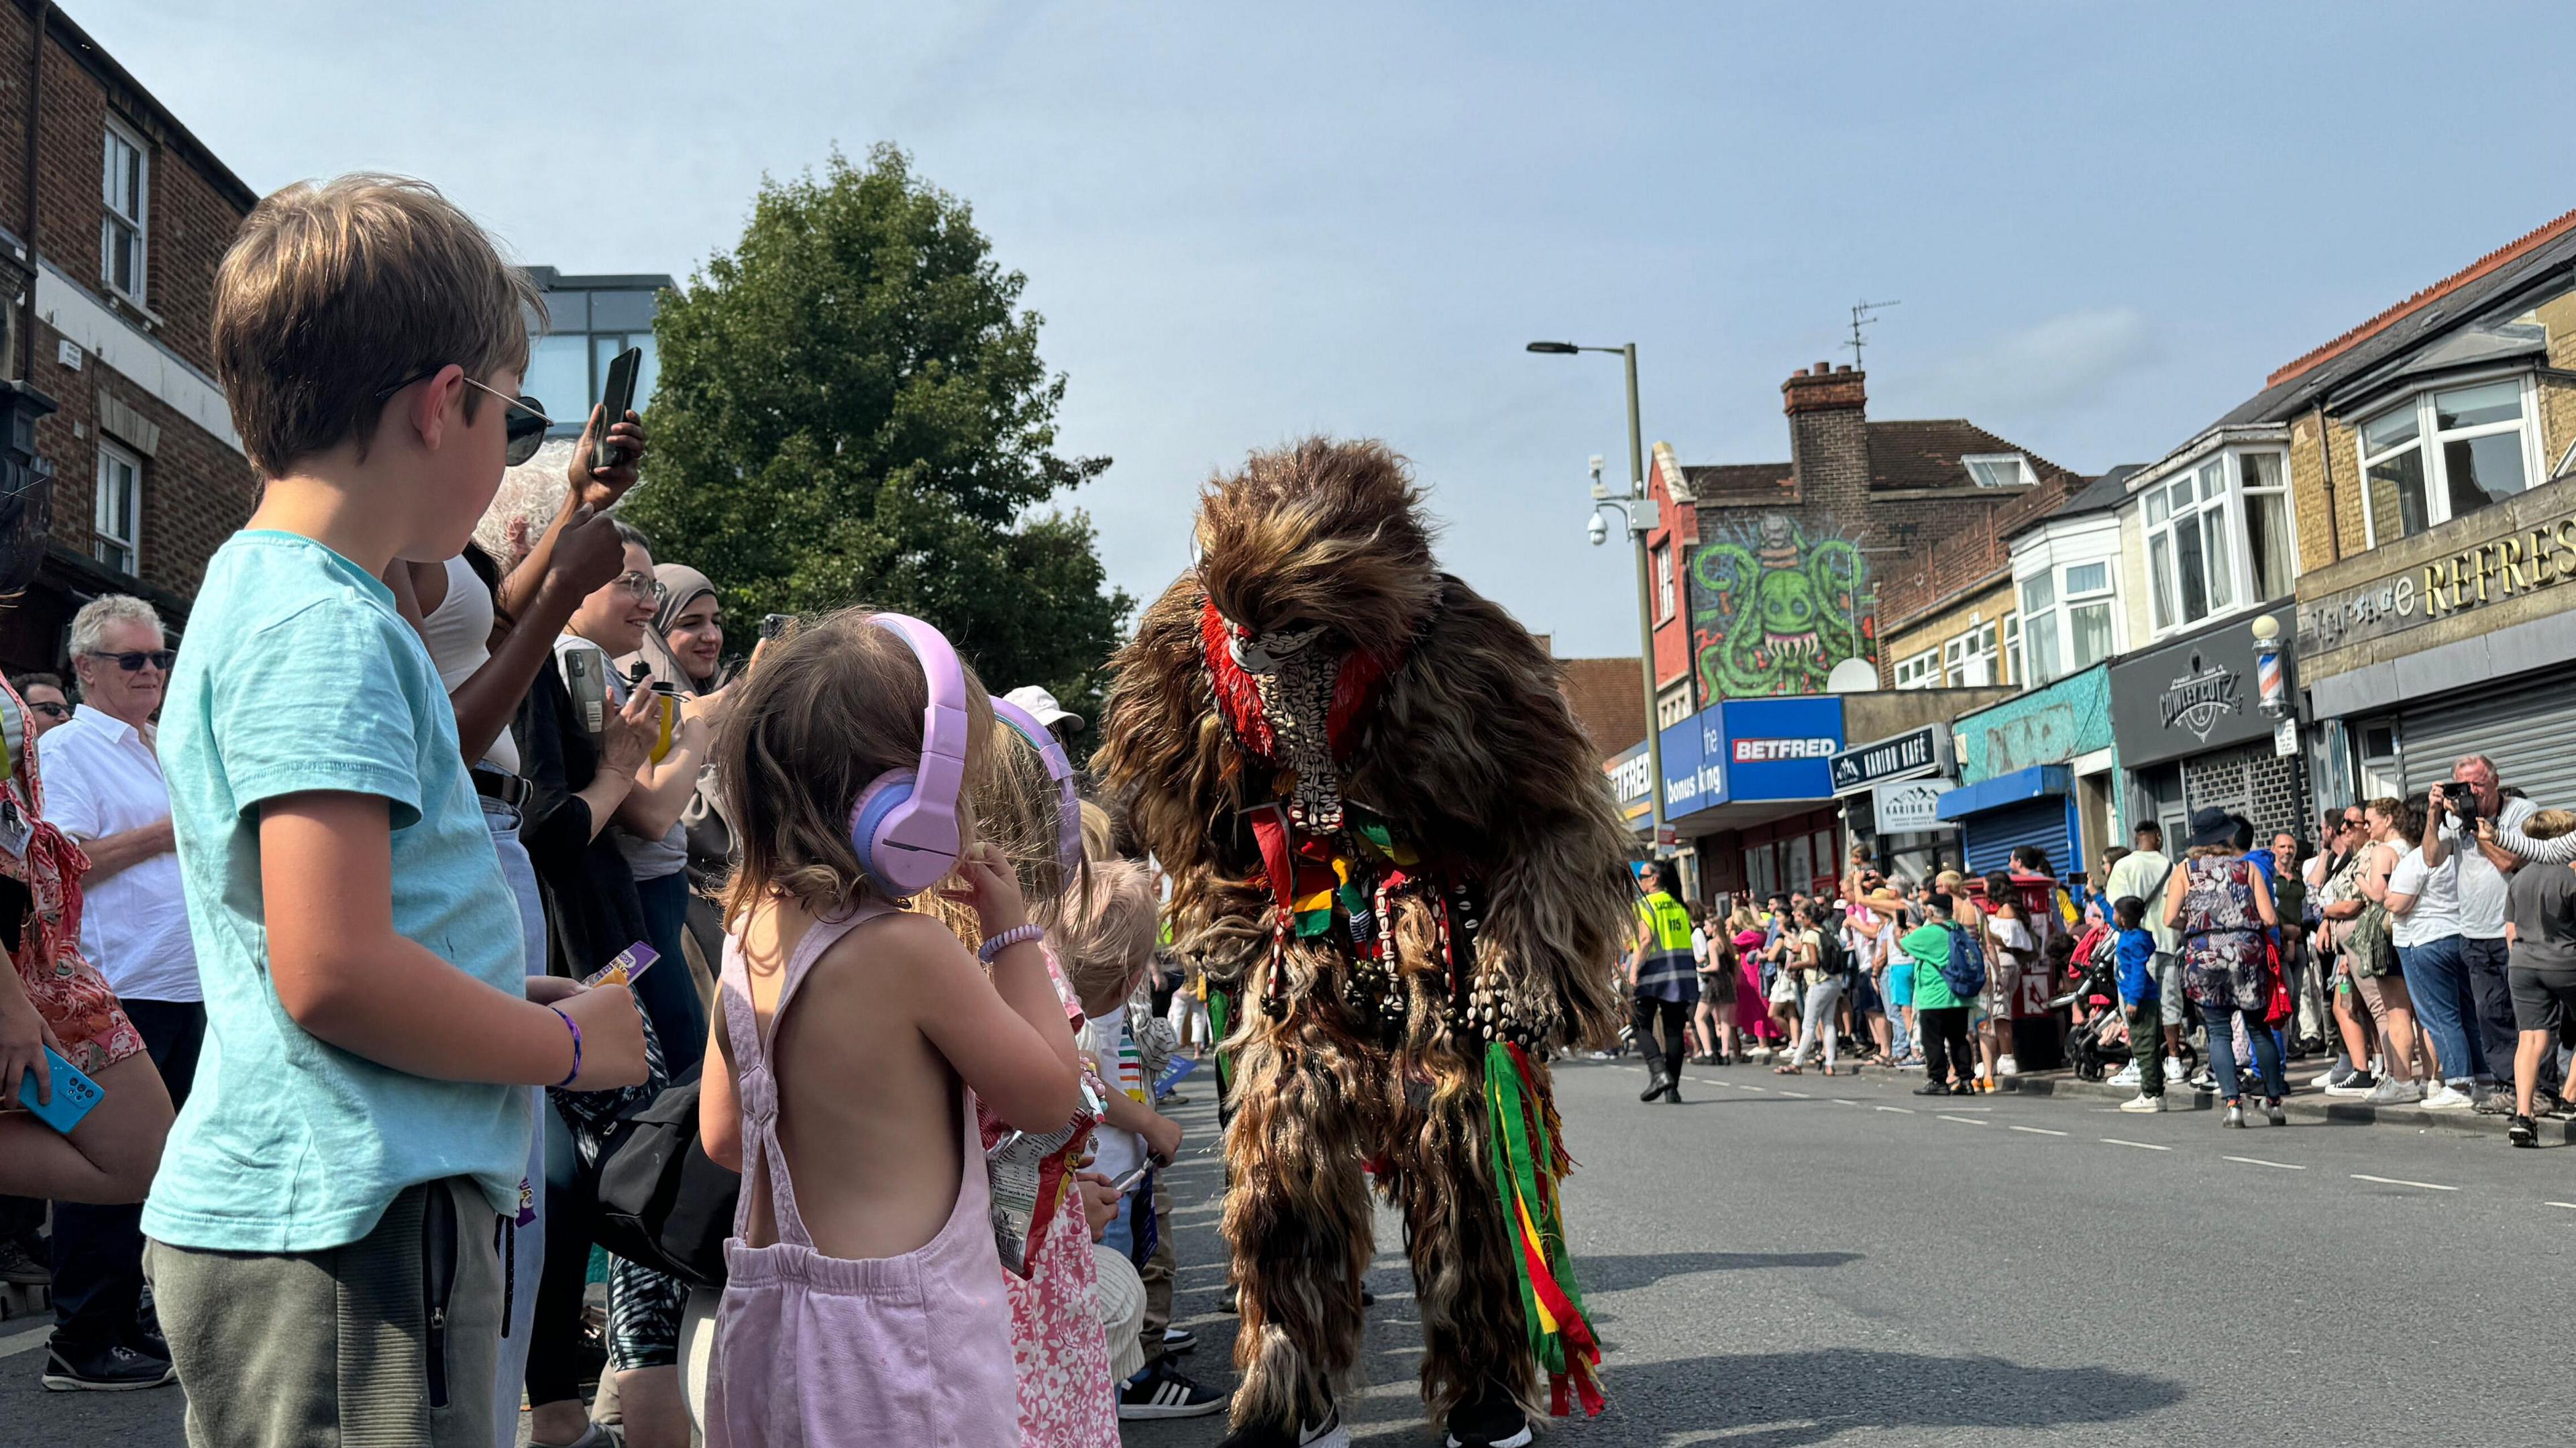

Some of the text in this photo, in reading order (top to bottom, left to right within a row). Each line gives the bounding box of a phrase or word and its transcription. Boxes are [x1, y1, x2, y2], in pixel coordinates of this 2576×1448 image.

[2159, 683, 2198, 727] COWLEY
[1703, 726, 1717, 755] the
[1736, 738, 1837, 761] BETFRED
[1610, 752, 1652, 803] TFRED
[1864, 745, 1898, 778] KARIBU
[1667, 764, 1721, 804] bonus king
[1886, 803, 1923, 815] KARIBU
